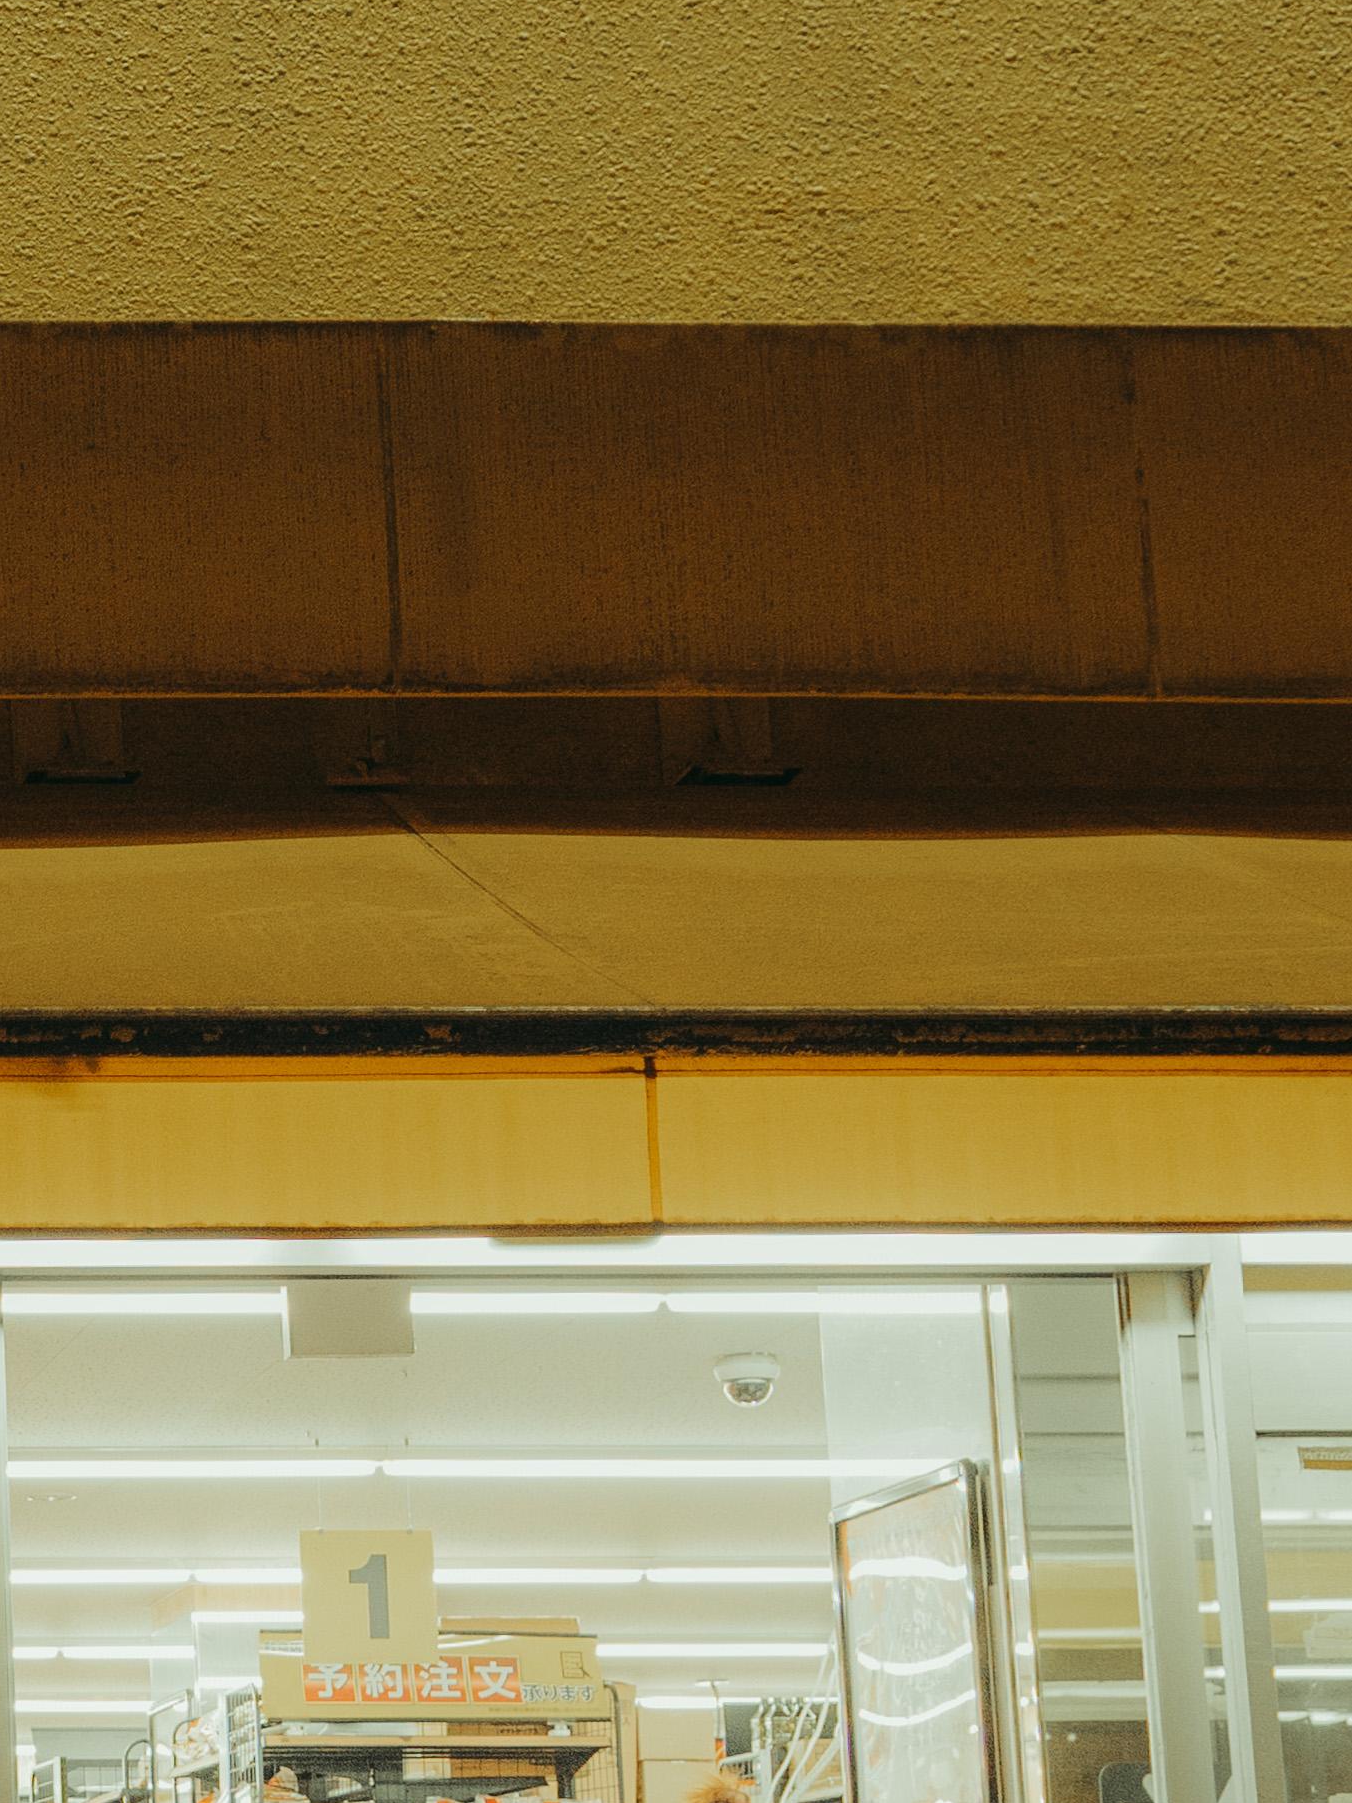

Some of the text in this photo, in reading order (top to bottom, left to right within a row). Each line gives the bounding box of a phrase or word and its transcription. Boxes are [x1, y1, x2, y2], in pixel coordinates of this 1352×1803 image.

[349, 1554, 390, 1638] 1
[307, 1661, 516, 1699] 予約注文
